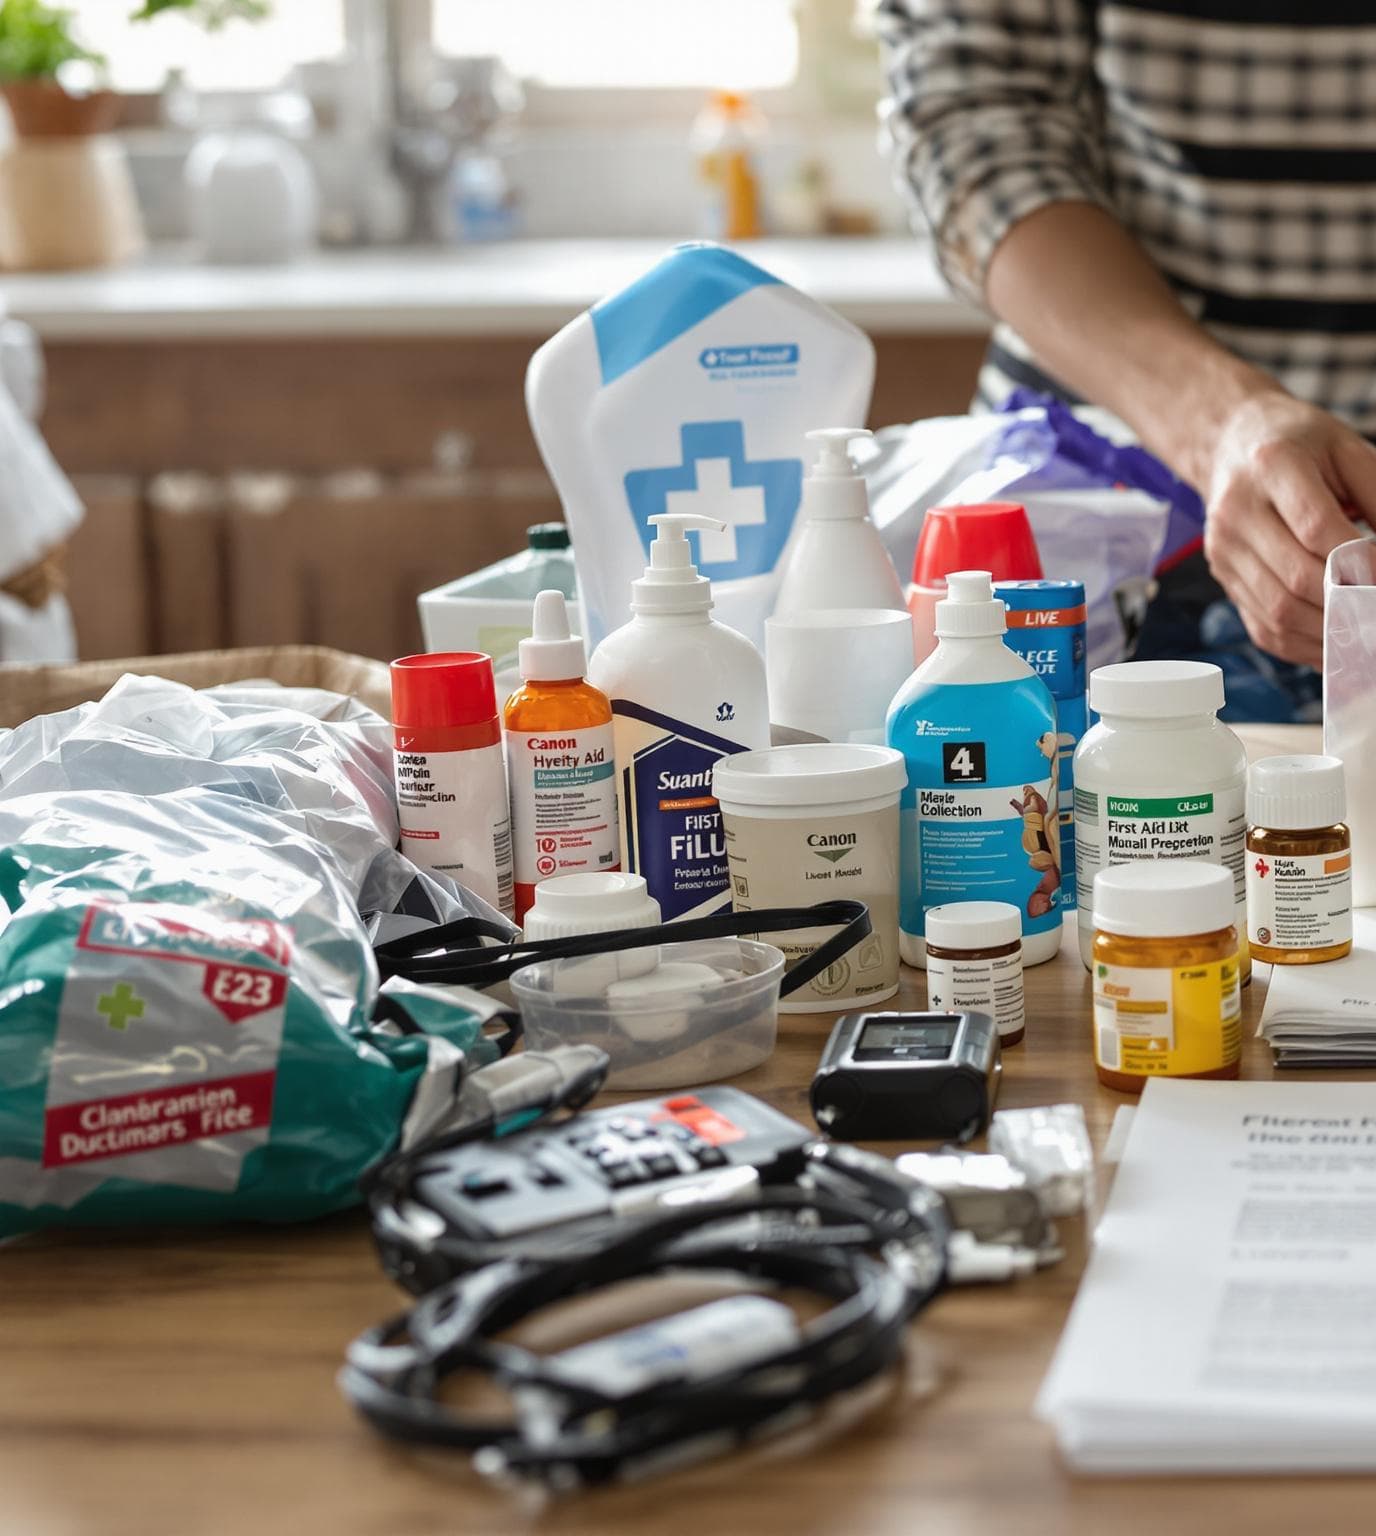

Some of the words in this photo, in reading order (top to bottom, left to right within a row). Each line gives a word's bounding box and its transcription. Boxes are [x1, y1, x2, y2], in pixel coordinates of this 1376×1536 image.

[1025, 612, 1060, 625] LIVE
[527, 737, 577, 750] Canon
[950, 747, 975, 776] 4
[807, 833, 856, 847] Canon
